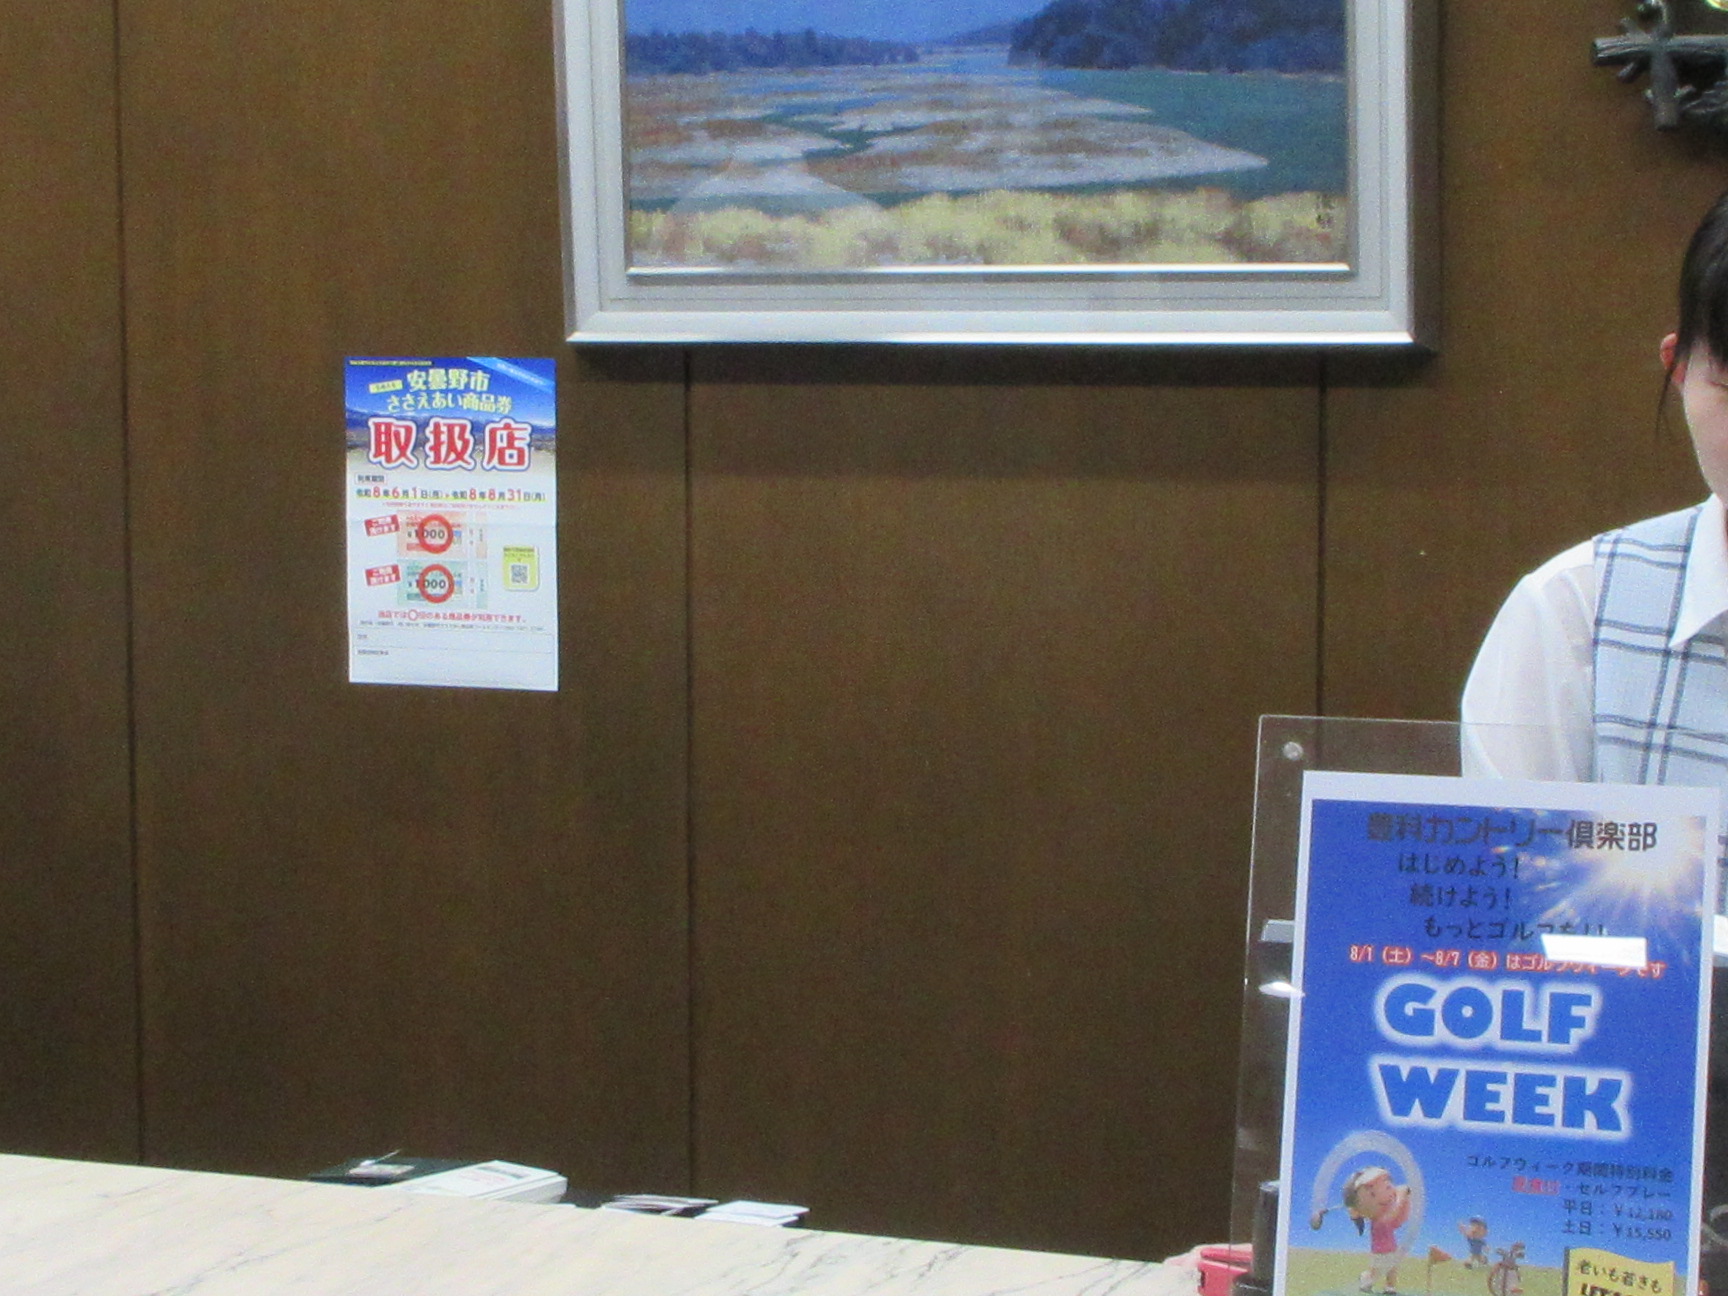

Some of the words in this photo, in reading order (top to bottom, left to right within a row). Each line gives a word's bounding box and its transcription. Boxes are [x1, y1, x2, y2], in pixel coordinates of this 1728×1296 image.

[406, 368, 491, 392] 安曇野市
[386, 391, 513, 415] ささえあい商品券
[370, 418, 530, 468] 取扱店
[1367, 812, 1658, 852] 豊科カントリー倶楽部
[1382, 980, 1594, 1045] GOLF
[1377, 1063, 1629, 1134] WEEK
